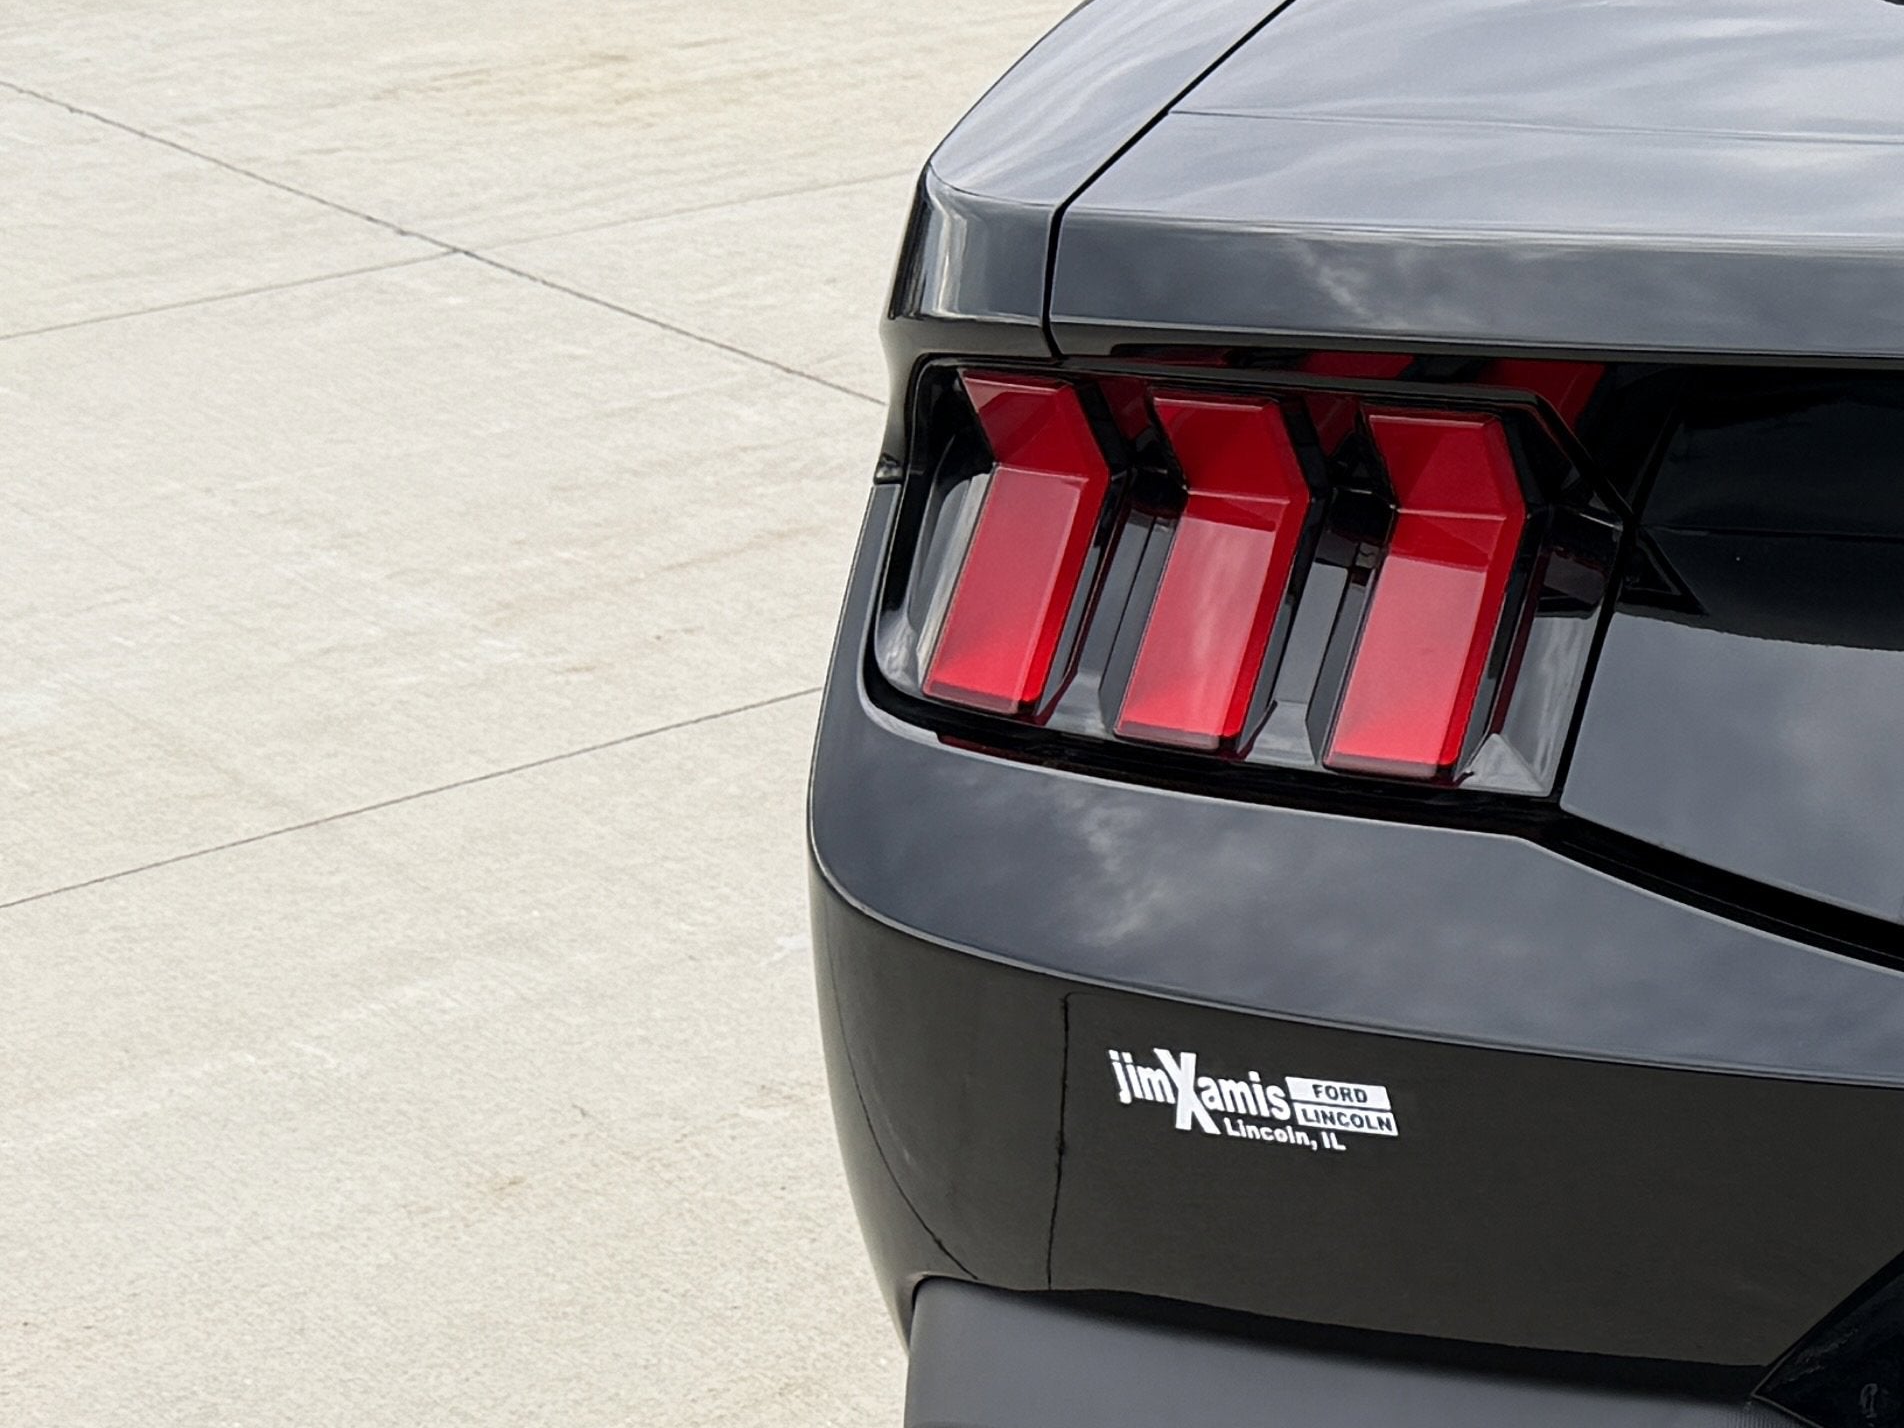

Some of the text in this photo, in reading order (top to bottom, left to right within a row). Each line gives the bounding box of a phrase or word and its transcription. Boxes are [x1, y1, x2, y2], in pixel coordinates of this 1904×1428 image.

[1312, 1083, 1369, 1104] FORD
[1300, 1107, 1393, 1132] LINCOLN
[1223, 1117, 1348, 1151] Lincoln, IL
